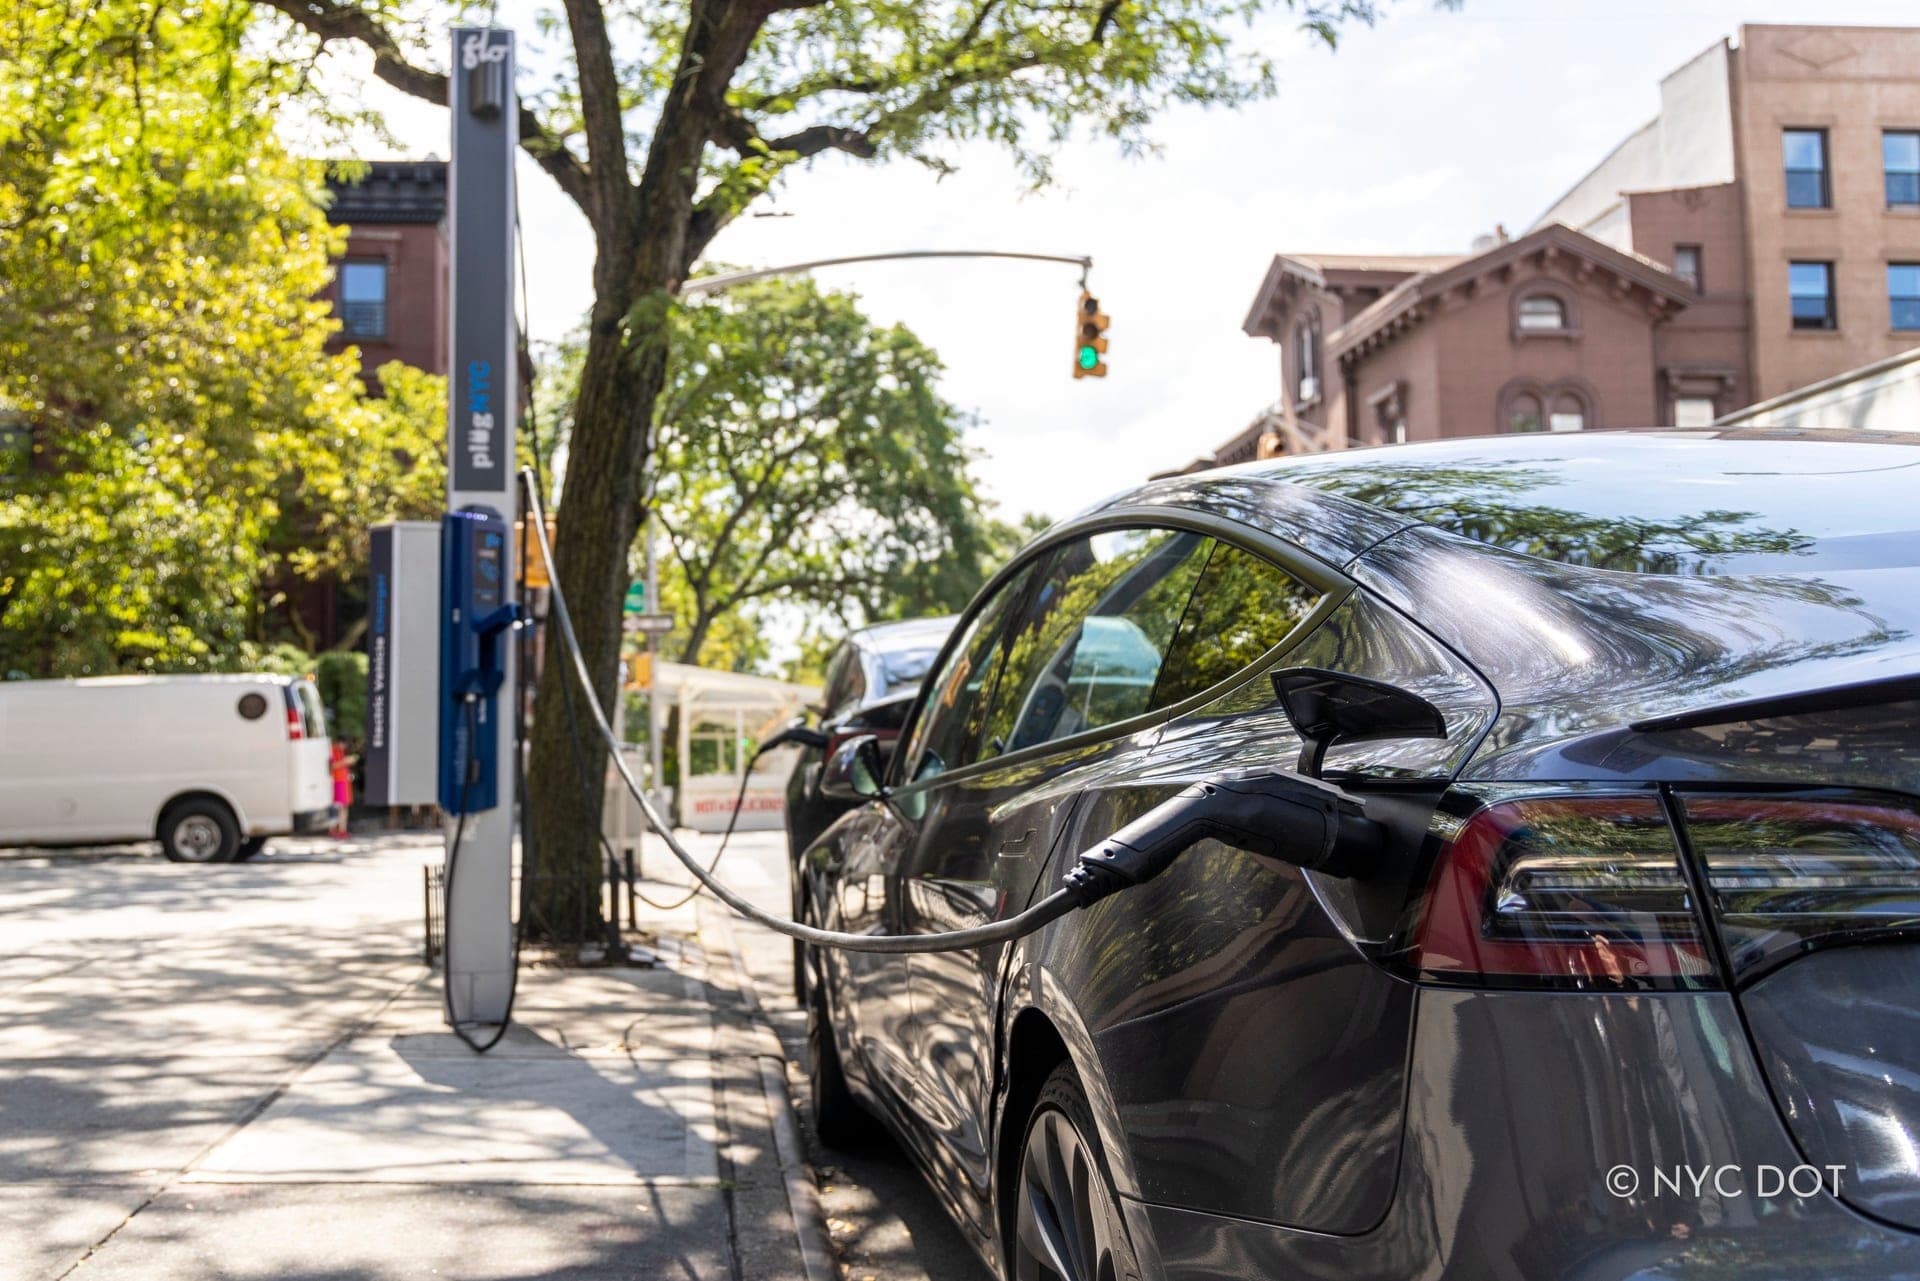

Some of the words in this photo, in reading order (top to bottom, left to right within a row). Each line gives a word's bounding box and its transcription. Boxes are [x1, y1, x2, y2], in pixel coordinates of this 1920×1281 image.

[462, 29, 509, 70] flo
[373, 635, 386, 692] Vehicle
[372, 694, 385, 748] Electric
